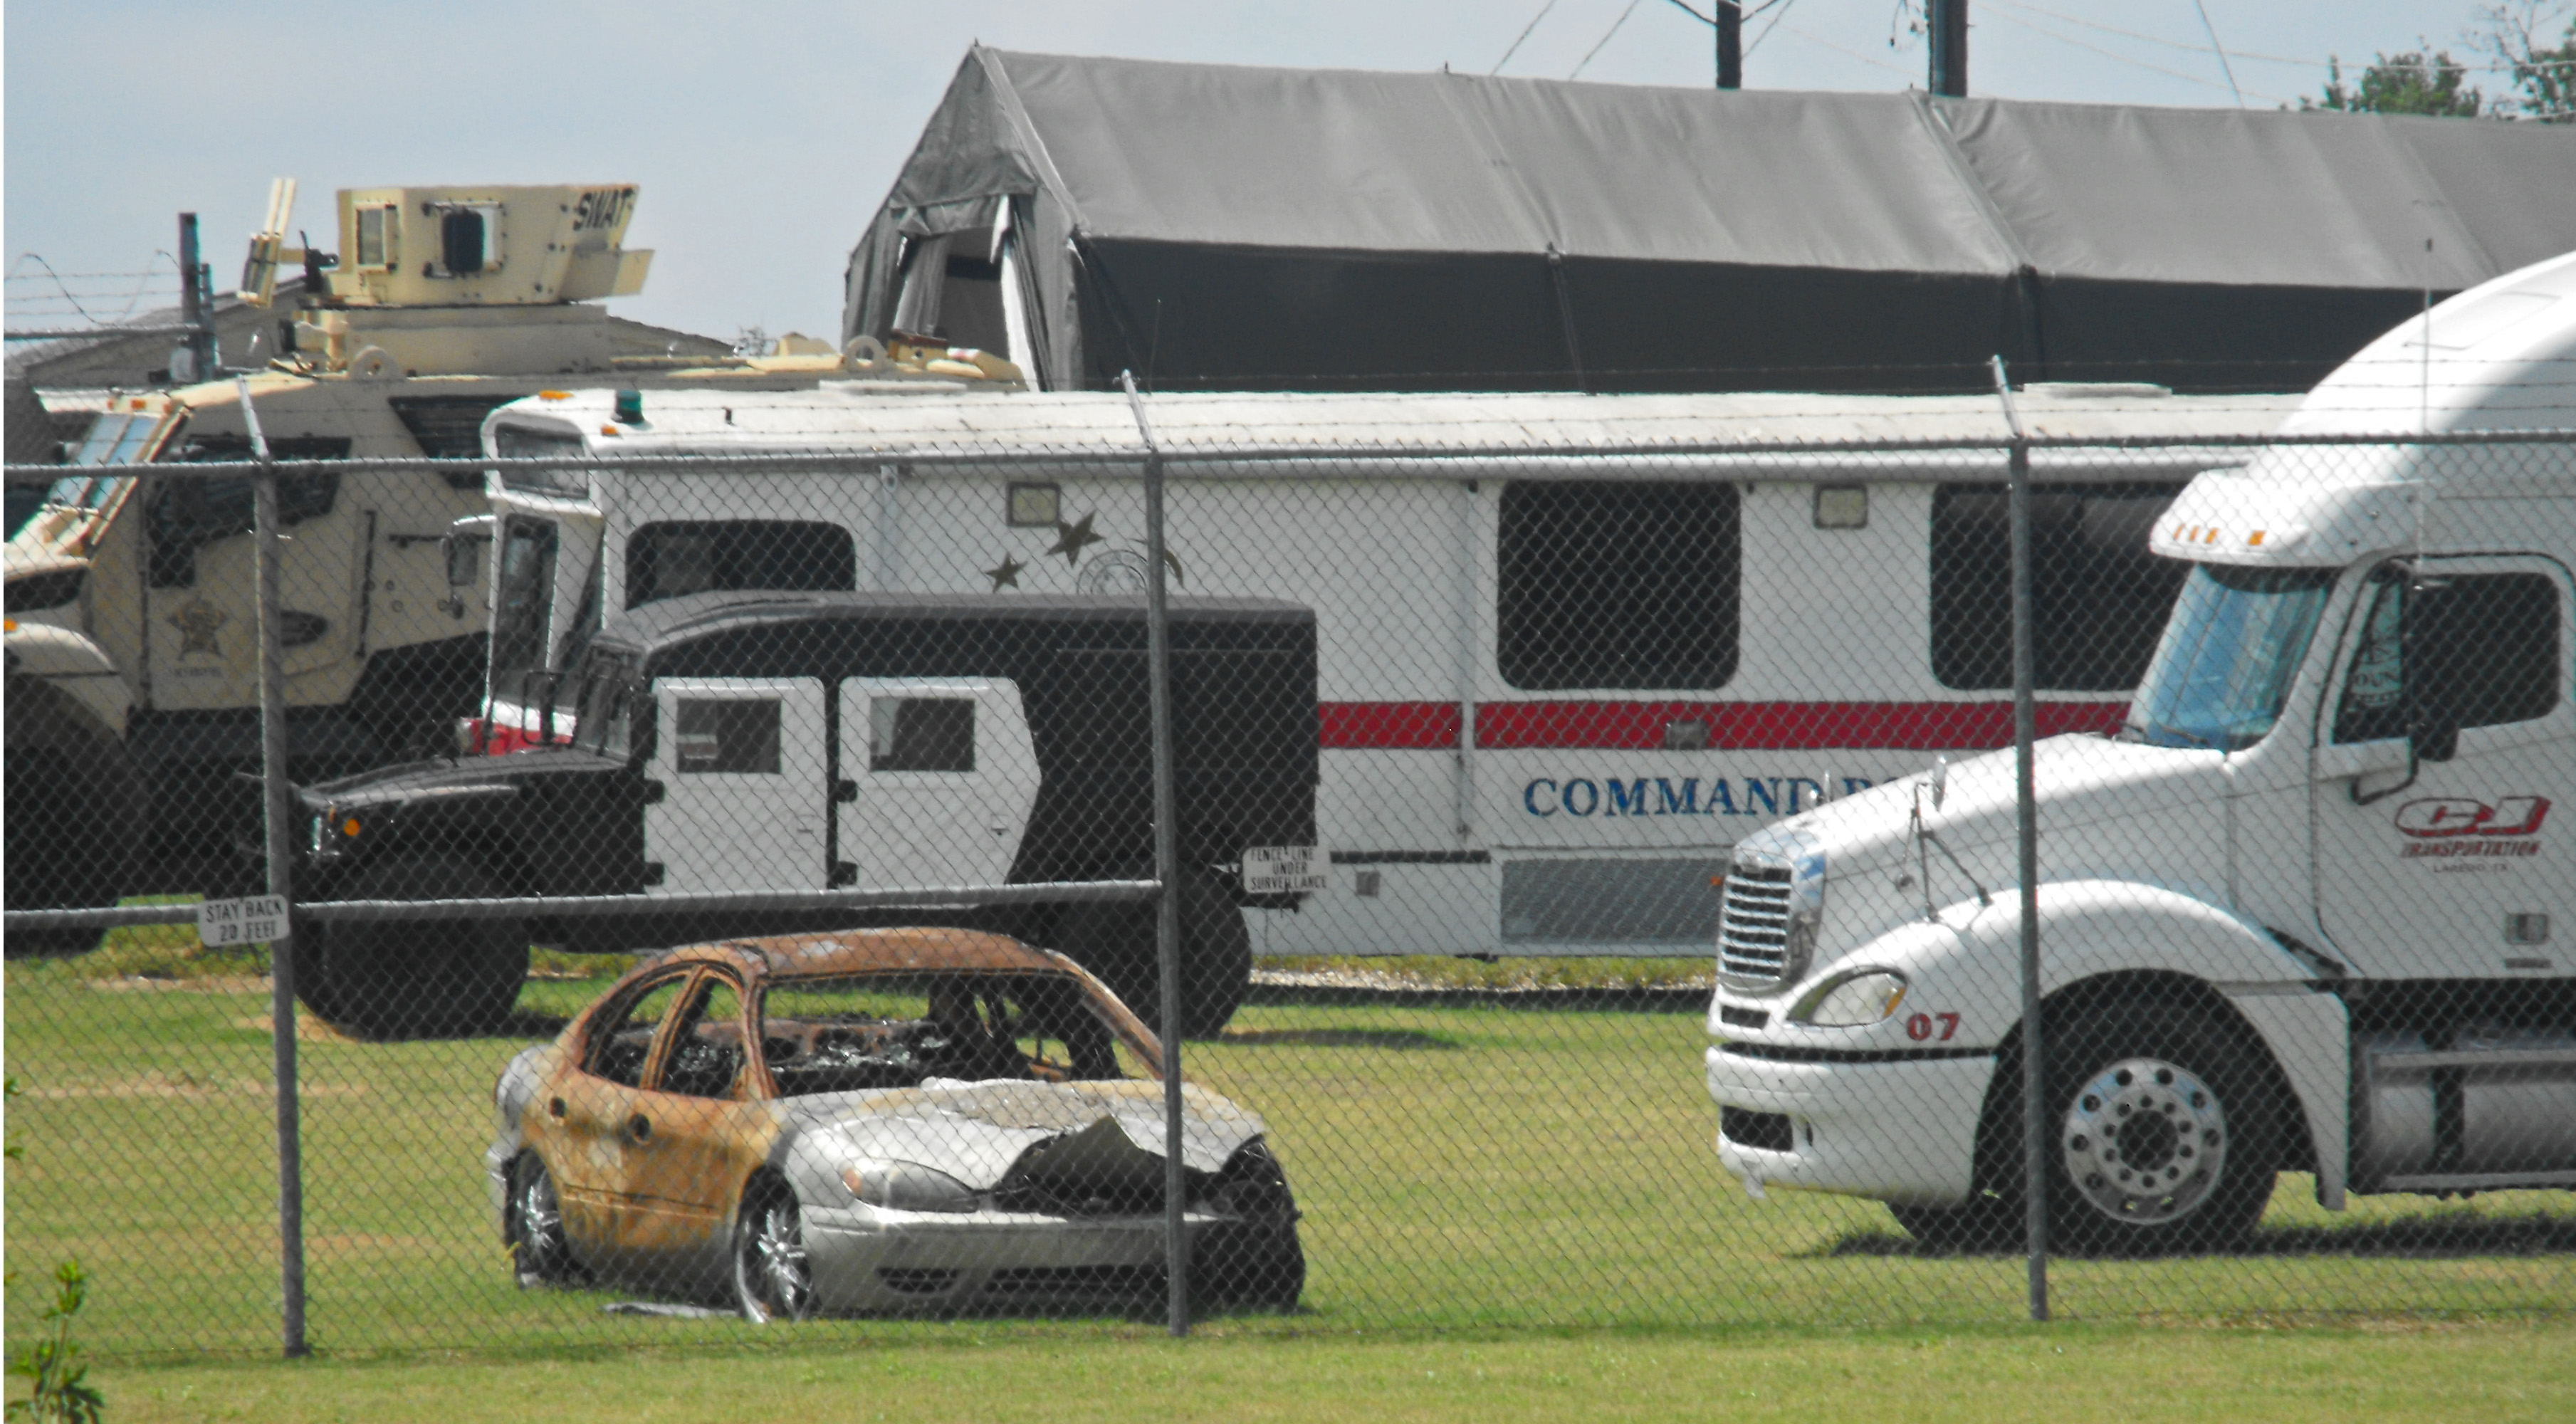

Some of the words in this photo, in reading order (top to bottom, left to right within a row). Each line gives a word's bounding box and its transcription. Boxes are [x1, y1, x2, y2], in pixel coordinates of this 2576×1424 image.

[572, 187, 635, 231] SWAT
[1524, 777, 1823, 817] COMMAND
[2401, 840, 2541, 858] TRANSPORTATION
[1272, 861, 1308, 876] UNDER
[1250, 875, 1327, 891] SURVEILLANCE
[205, 901, 240, 923] STAY
[244, 899, 283, 918] BACK
[219, 923, 238, 941] 20
[244, 919, 276, 938] FEET
[1907, 1012, 1961, 1042] 07
